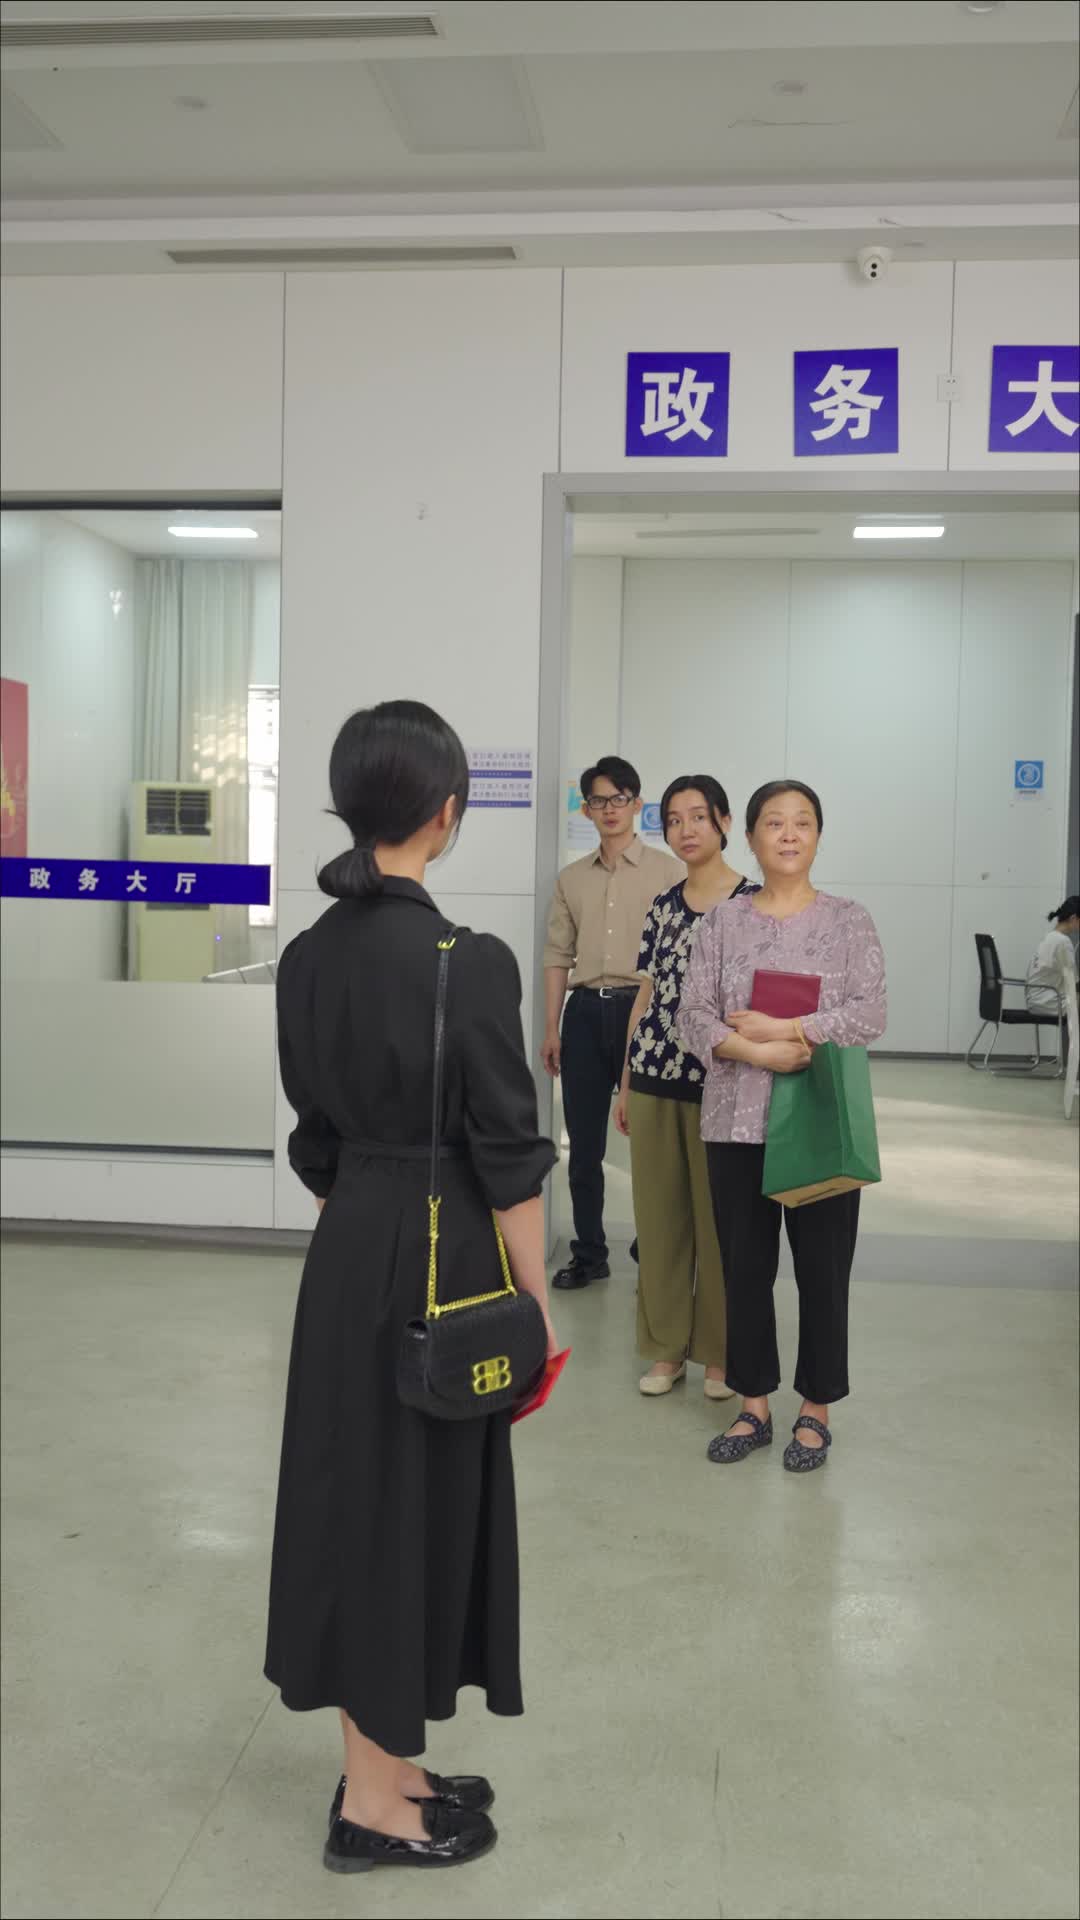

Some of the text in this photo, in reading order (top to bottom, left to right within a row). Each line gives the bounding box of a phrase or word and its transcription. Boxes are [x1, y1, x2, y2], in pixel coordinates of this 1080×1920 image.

[640, 361, 1080, 442] 政务大
[29, 867, 197, 894] 政务大厅
